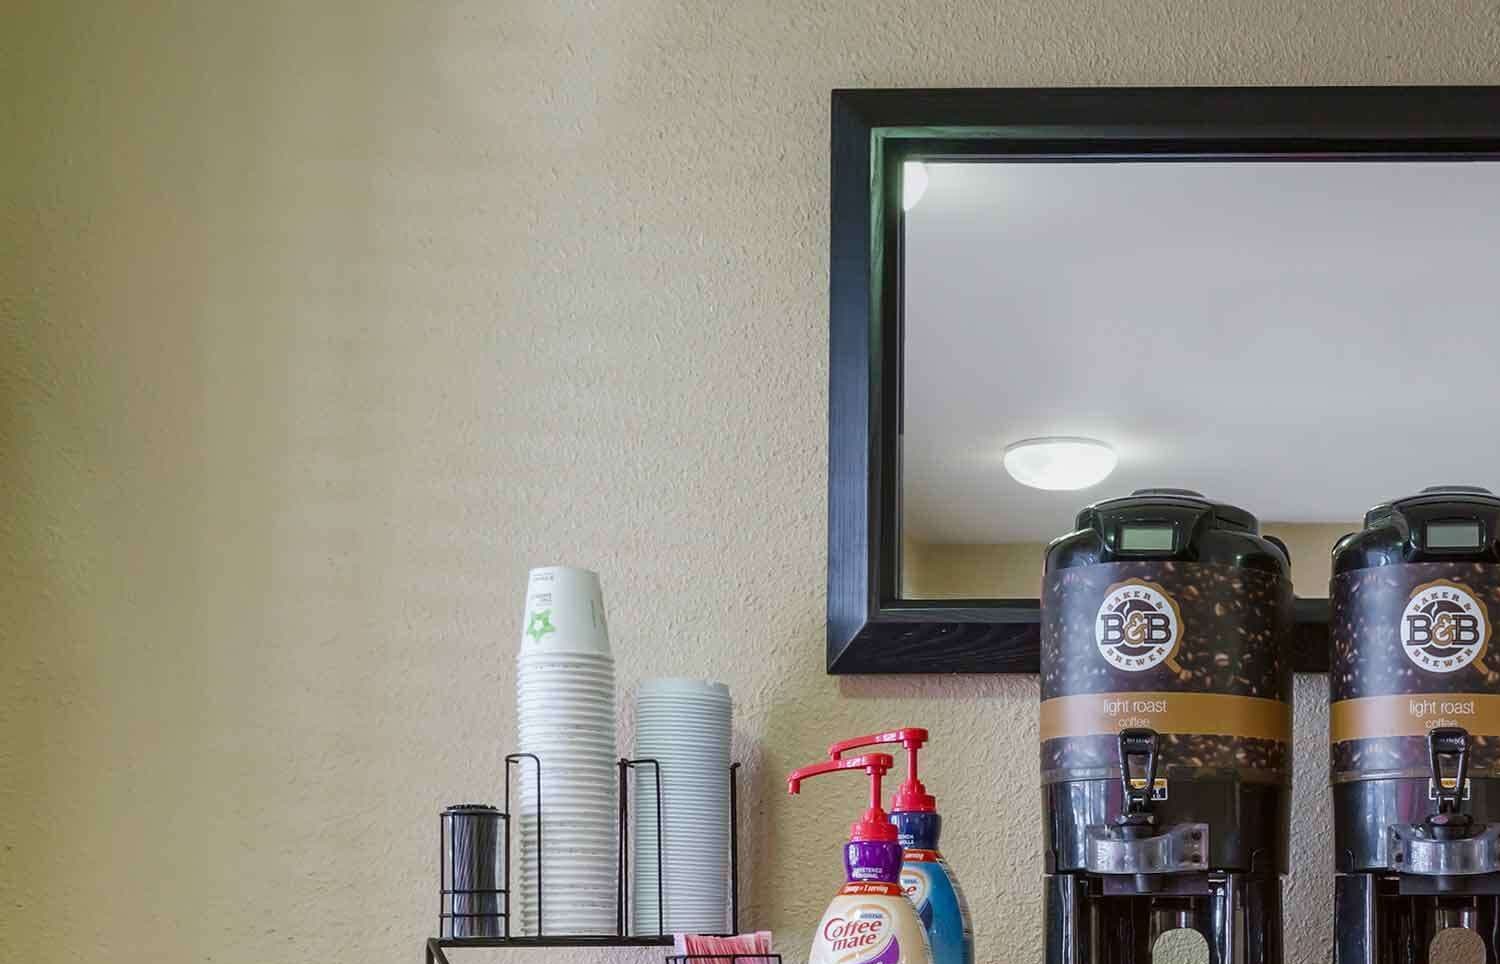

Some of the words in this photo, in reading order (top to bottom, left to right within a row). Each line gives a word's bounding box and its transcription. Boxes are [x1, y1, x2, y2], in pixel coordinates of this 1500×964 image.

[1103, 699, 1129, 717] light
[1133, 700, 1168, 713] roast
[1409, 699, 1437, 717] light
[1440, 701, 1475, 714] roast
[824, 918, 882, 942] Coffee
[832, 934, 877, 952] mate
